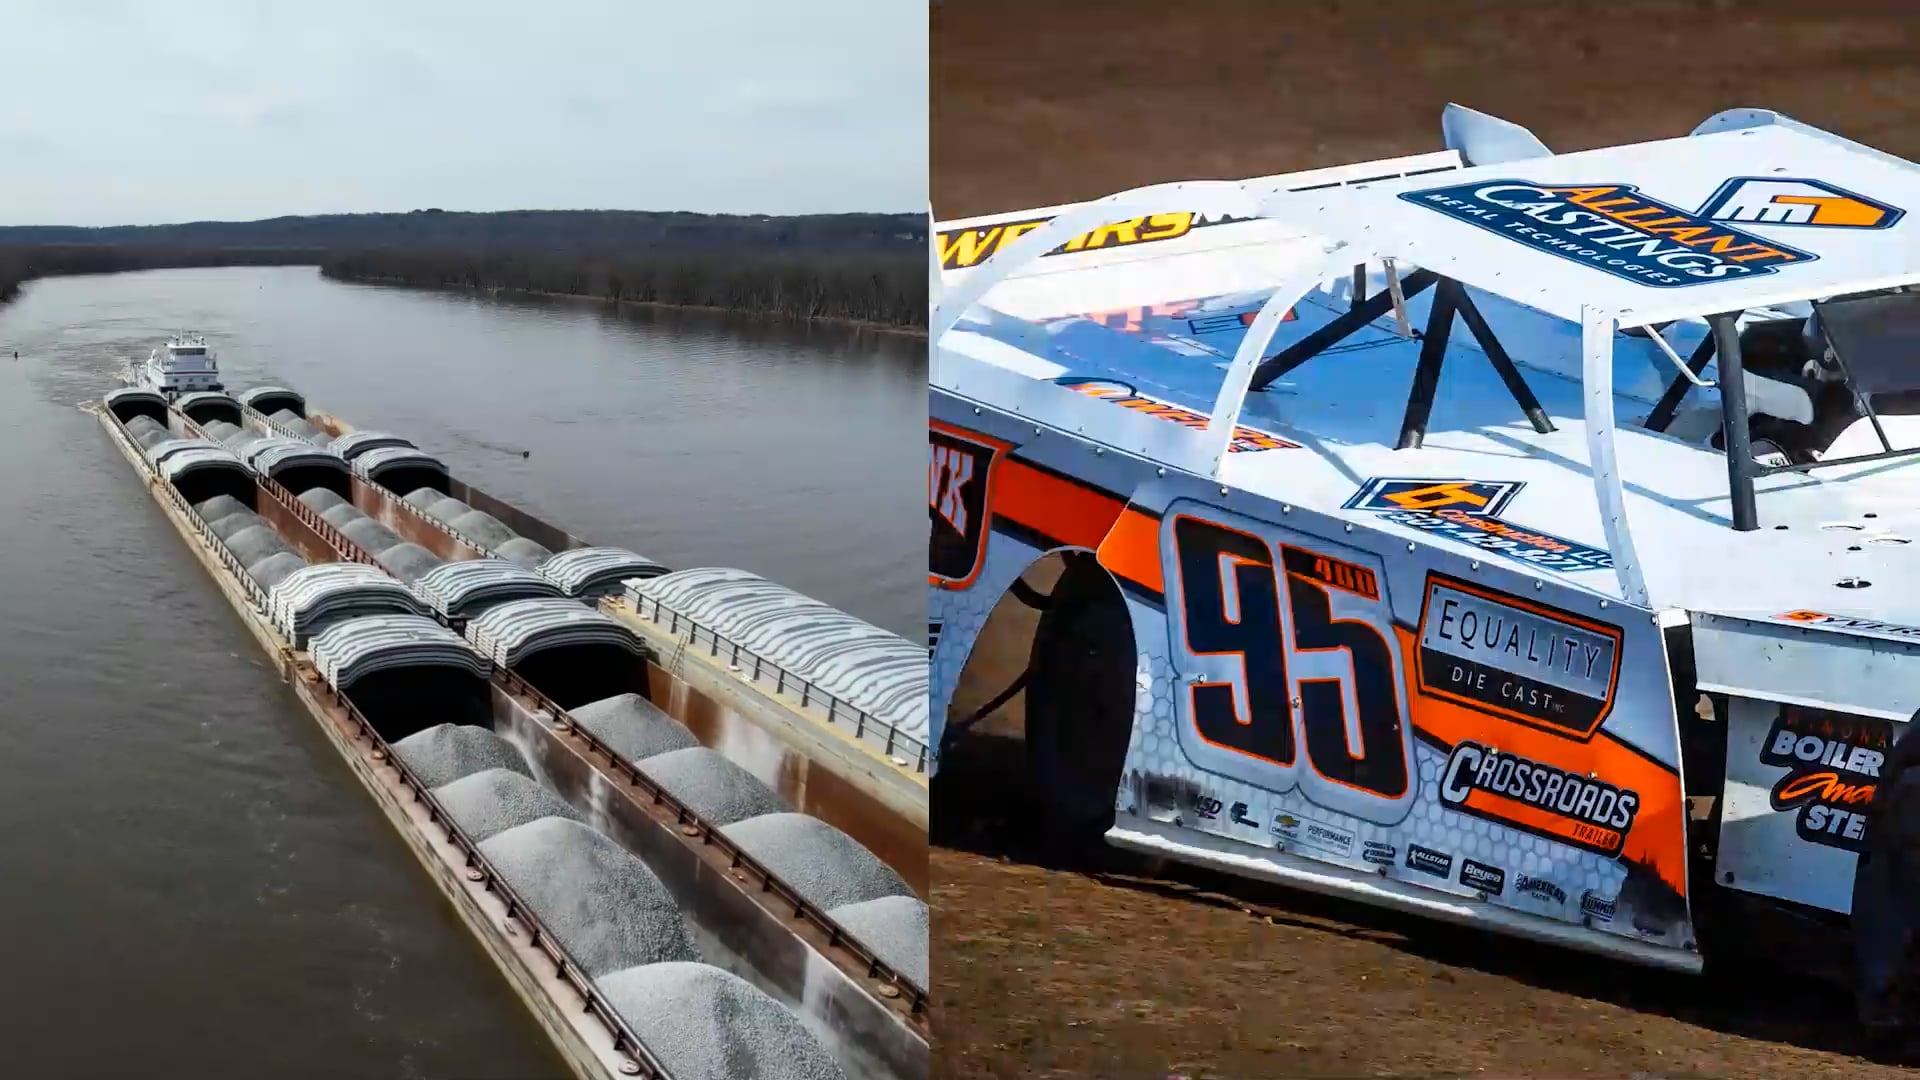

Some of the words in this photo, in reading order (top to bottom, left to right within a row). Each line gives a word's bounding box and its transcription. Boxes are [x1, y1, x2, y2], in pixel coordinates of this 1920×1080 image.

[1425, 194, 1493, 221] METAL
[1504, 221, 1681, 284] TECHNOLOGIES
[1474, 185, 1751, 278] CASTINGS
[1550, 187, 1798, 263] ALLIANT
[1435, 509, 1572, 553] Construction
[1312, 558, 1379, 600] 400
[1173, 513, 1409, 801] 95
[1439, 599, 1600, 679] EQUALITY
[1451, 666, 1488, 690] DIE
[1501, 682, 1552, 709] CAST
[1771, 729, 1886, 779] BOILER
[1442, 746, 1637, 829] CROSSROADS
[1307, 825, 1352, 845] PERFORMANCE
[1572, 822, 1619, 848] TRAILER
[1805, 804, 1867, 841] STE
[1416, 851, 1449, 866] ALLSTAR
